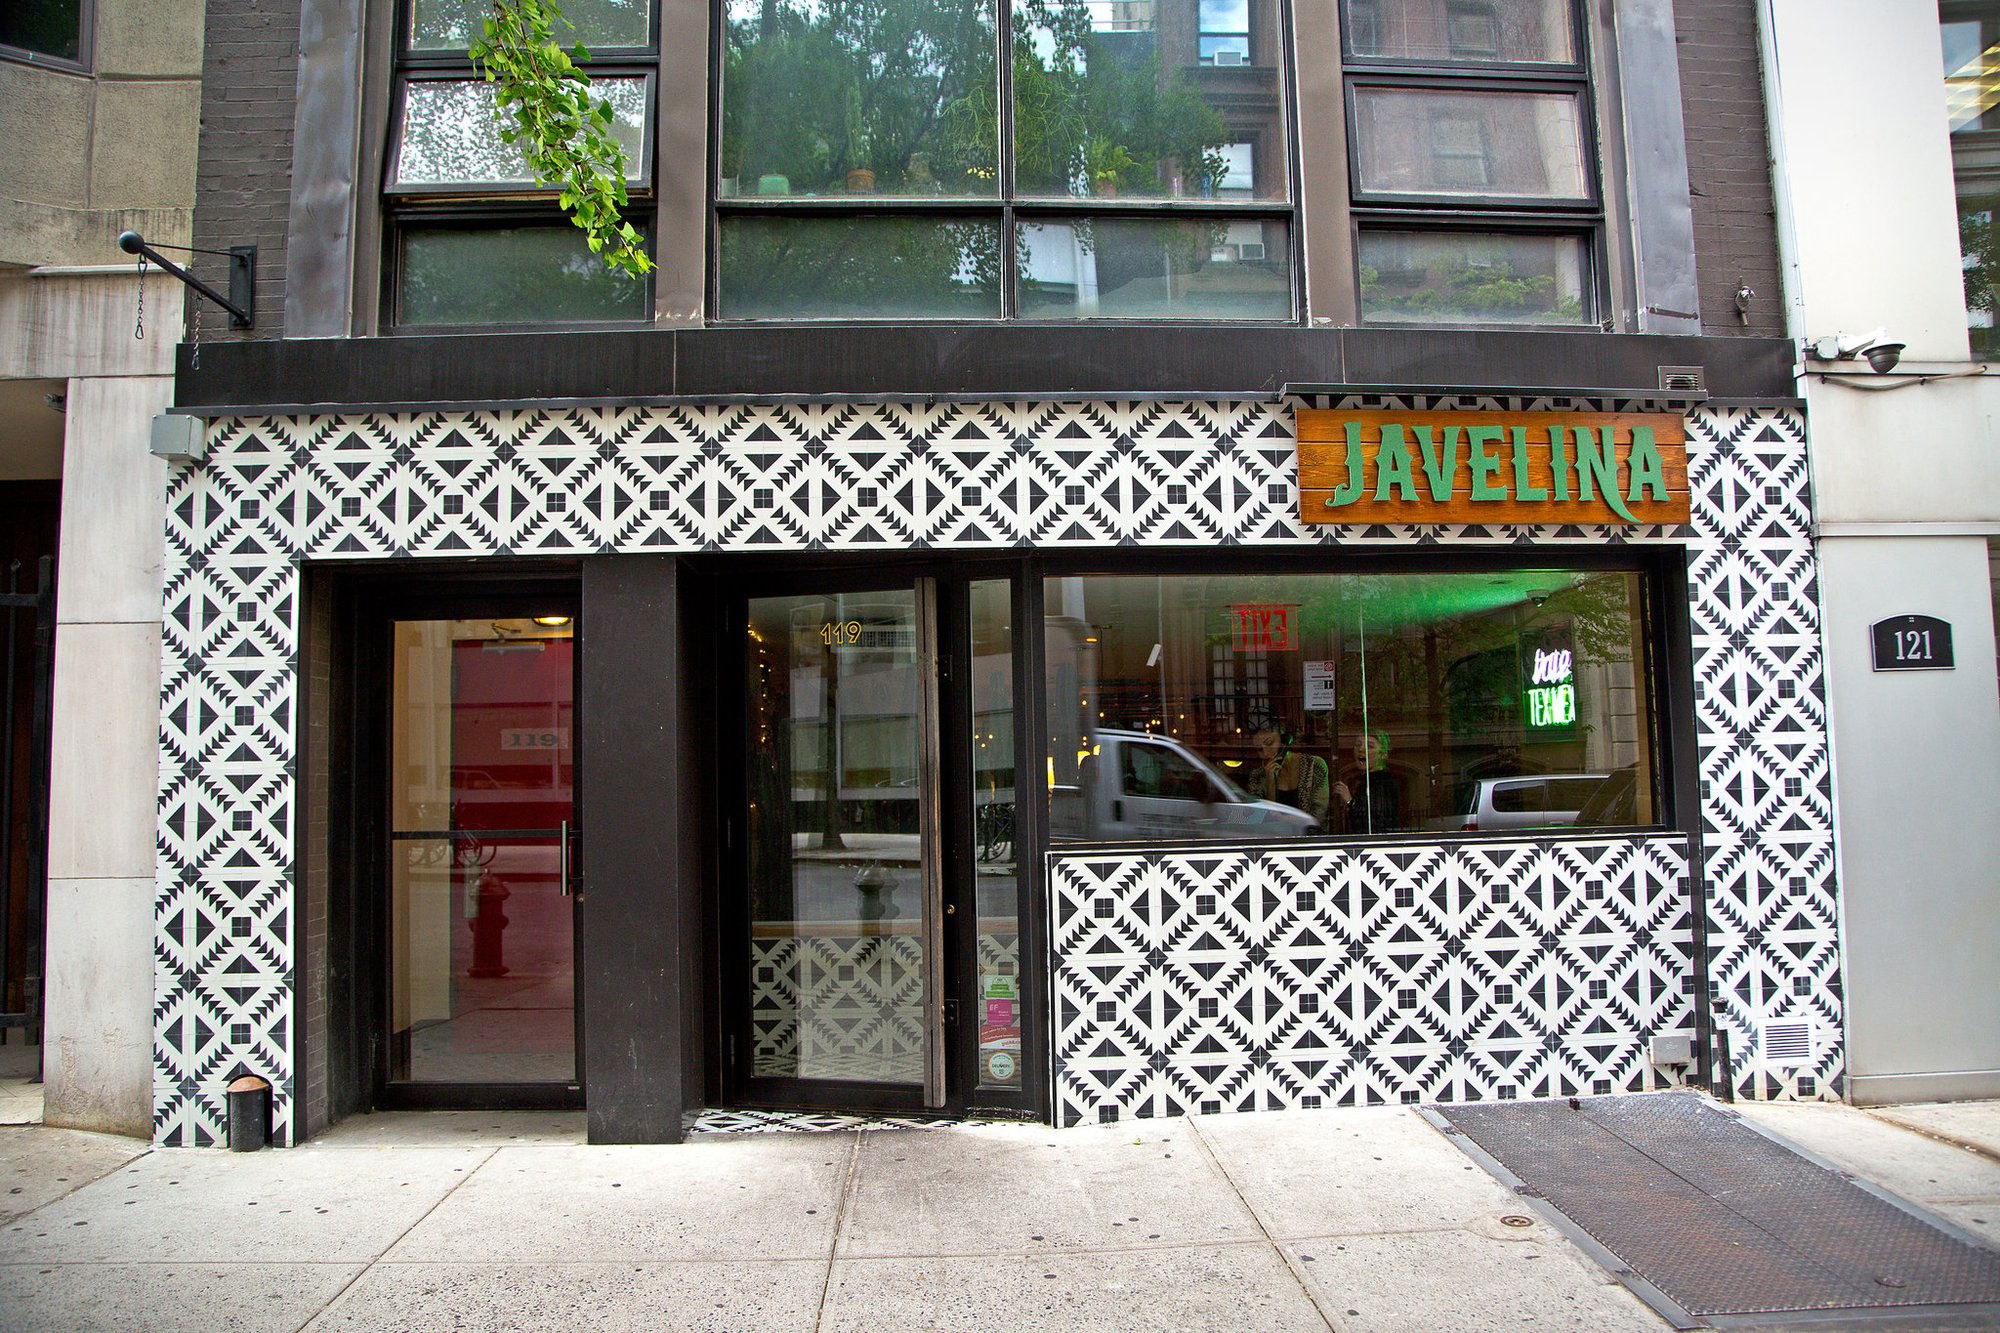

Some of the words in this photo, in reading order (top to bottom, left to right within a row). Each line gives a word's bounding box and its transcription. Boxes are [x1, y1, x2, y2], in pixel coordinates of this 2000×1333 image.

[1325, 422, 1671, 524] JAVELINA
[820, 621, 862, 645] 119
[1894, 630, 1932, 660] 121
[510, 733, 559, 747] 119
